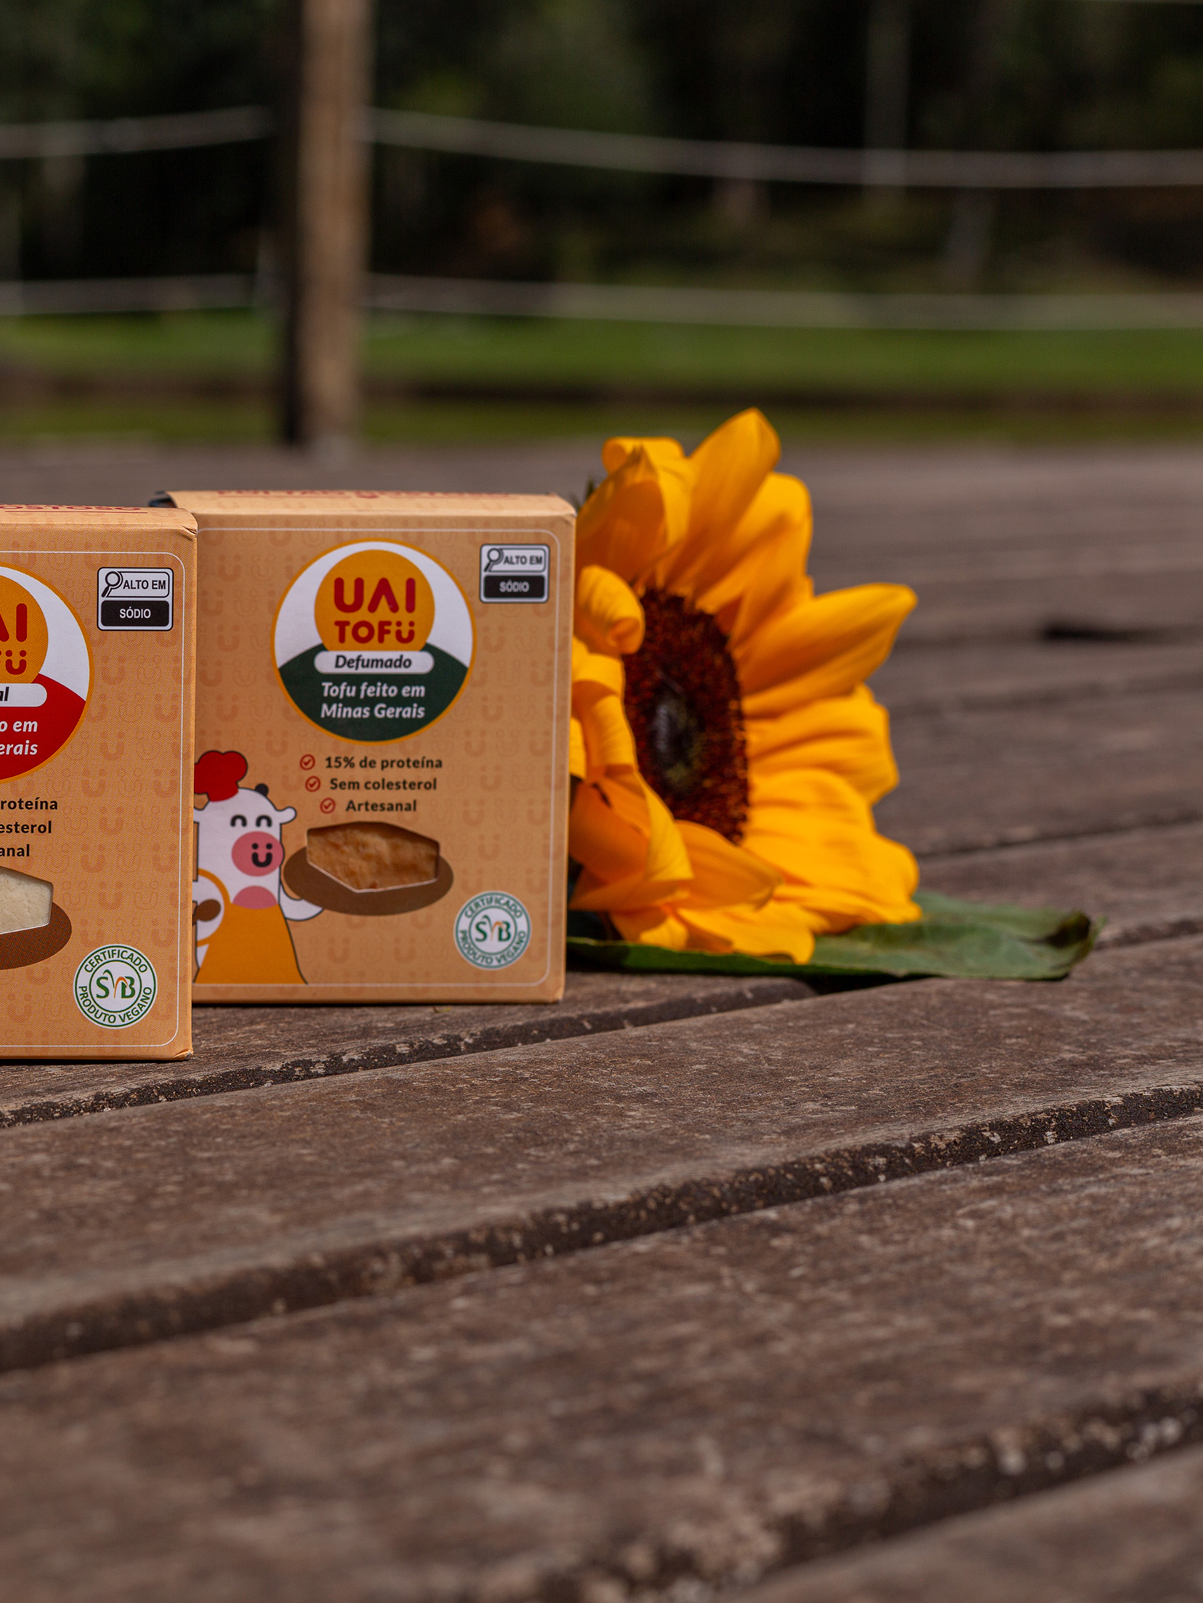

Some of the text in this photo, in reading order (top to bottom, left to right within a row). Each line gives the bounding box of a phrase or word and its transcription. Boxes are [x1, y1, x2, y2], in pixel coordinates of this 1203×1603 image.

[503, 555, 543, 566] ALTO EM
[122, 579, 167, 590] ALTO EM
[499, 579, 530, 593] SÓDIO
[333, 577, 417, 614] UAI
[119, 606, 152, 619] SÓDIO
[334, 654, 412, 670] Defumado
[321, 682, 426, 699] Tofu feito em
[321, 703, 426, 719] Minas Gerais
[12, 719, 39, 733] em
[324, 755, 443, 772] 15% de proteína
[329, 777, 438, 791] Sem colesterol
[345, 799, 418, 813] Artesanal
[84, 949, 148, 973] CERTIFICADO
[78, 985, 153, 1024] PRODUTO VEGANO
